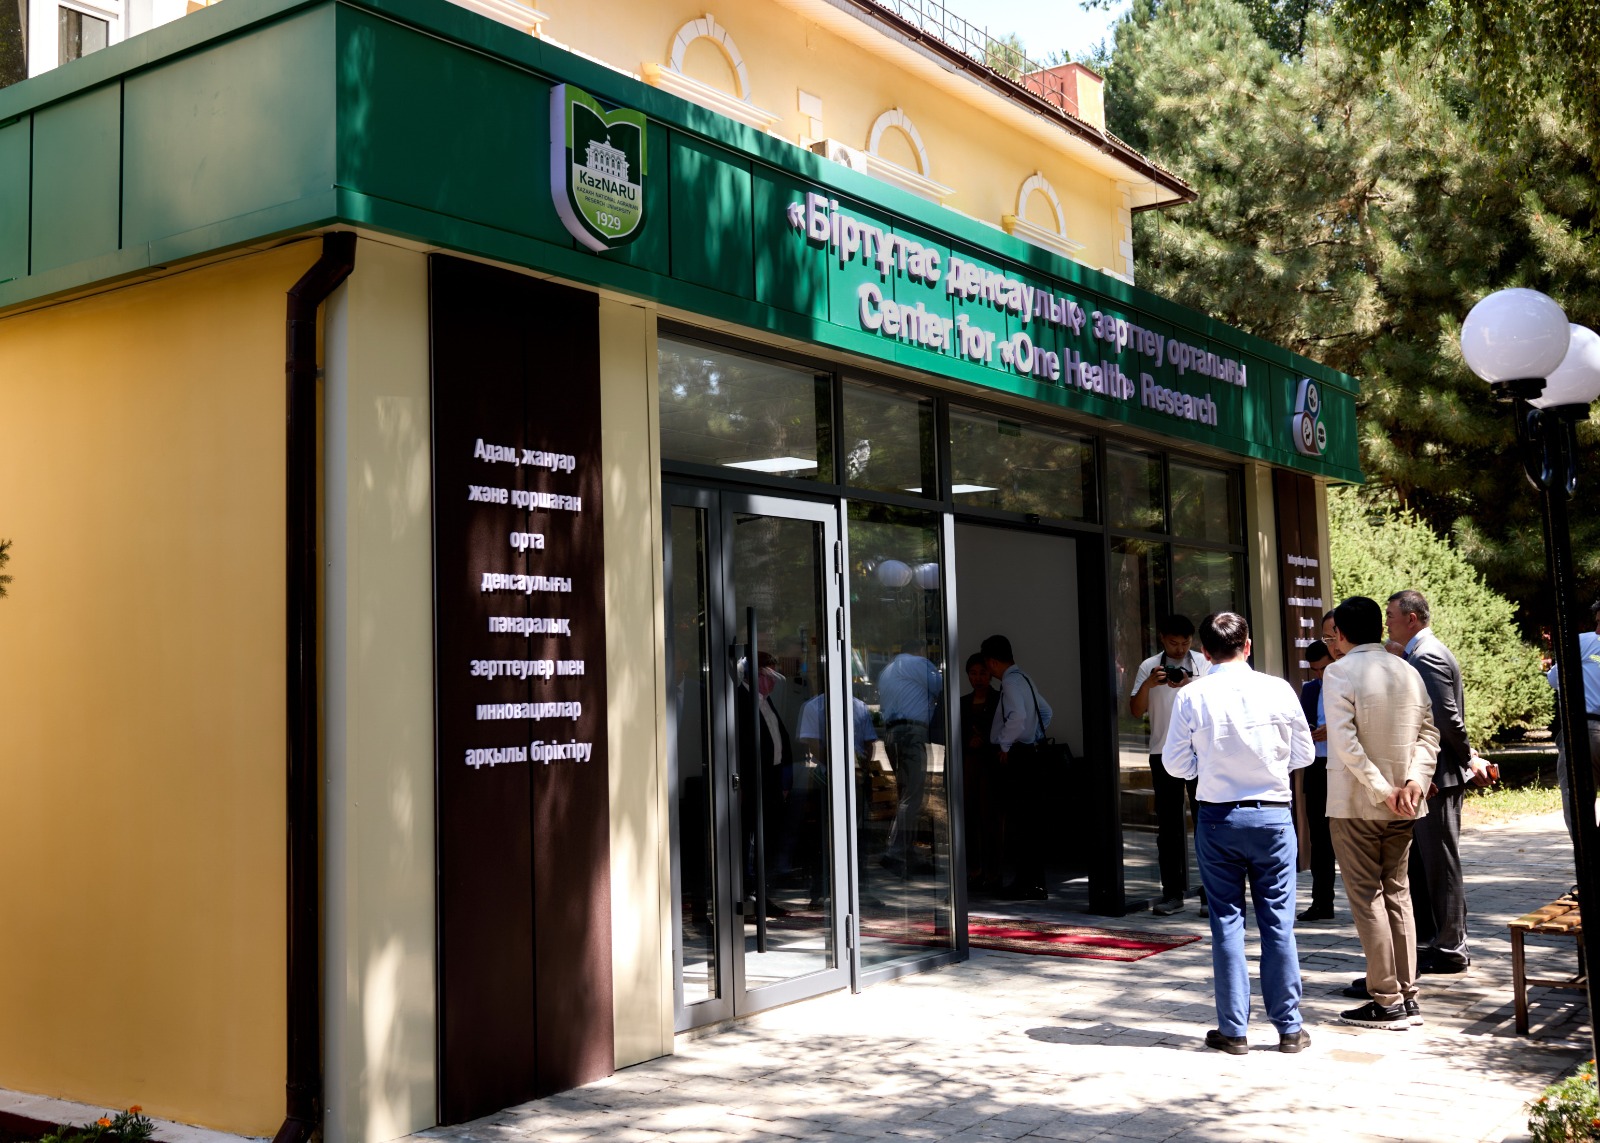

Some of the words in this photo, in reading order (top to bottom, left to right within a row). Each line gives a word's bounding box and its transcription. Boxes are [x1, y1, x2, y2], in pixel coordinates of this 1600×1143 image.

[577, 186, 594, 196] KAZAKH
[596, 192, 616, 203] NATIONAL
[580, 170, 635, 200] KazNARU
[596, 210, 621, 230] 1929
[787, 191, 941, 282] «Біртұтас
[946, 257, 1087, 336] денсаулық»
[1092, 310, 1164, 367] зерттеу
[1167, 338, 1247, 388] орталығы
[858, 282, 954, 350] Center
[956, 313, 995, 362] for
[997, 332, 1060, 381] «One
[1064, 347, 1135, 400] Health»
[1140, 372, 1218, 426] Research
[473, 438, 520, 467] Адам,
[521, 449, 576, 474] жануар
[468, 485, 508, 504] және
[511, 490, 582, 512] қоршаған
[509, 531, 545, 552] орта
[480, 573, 572, 595] денсаулығы
[488, 616, 571, 637] пәнаралық
[470, 660, 554, 680] зерттеулер
[557, 660, 585, 675] мен
[476, 701, 582, 721] инновациялар
[465, 746, 527, 769] арқылы
[530, 738, 592, 764] біріктіру
